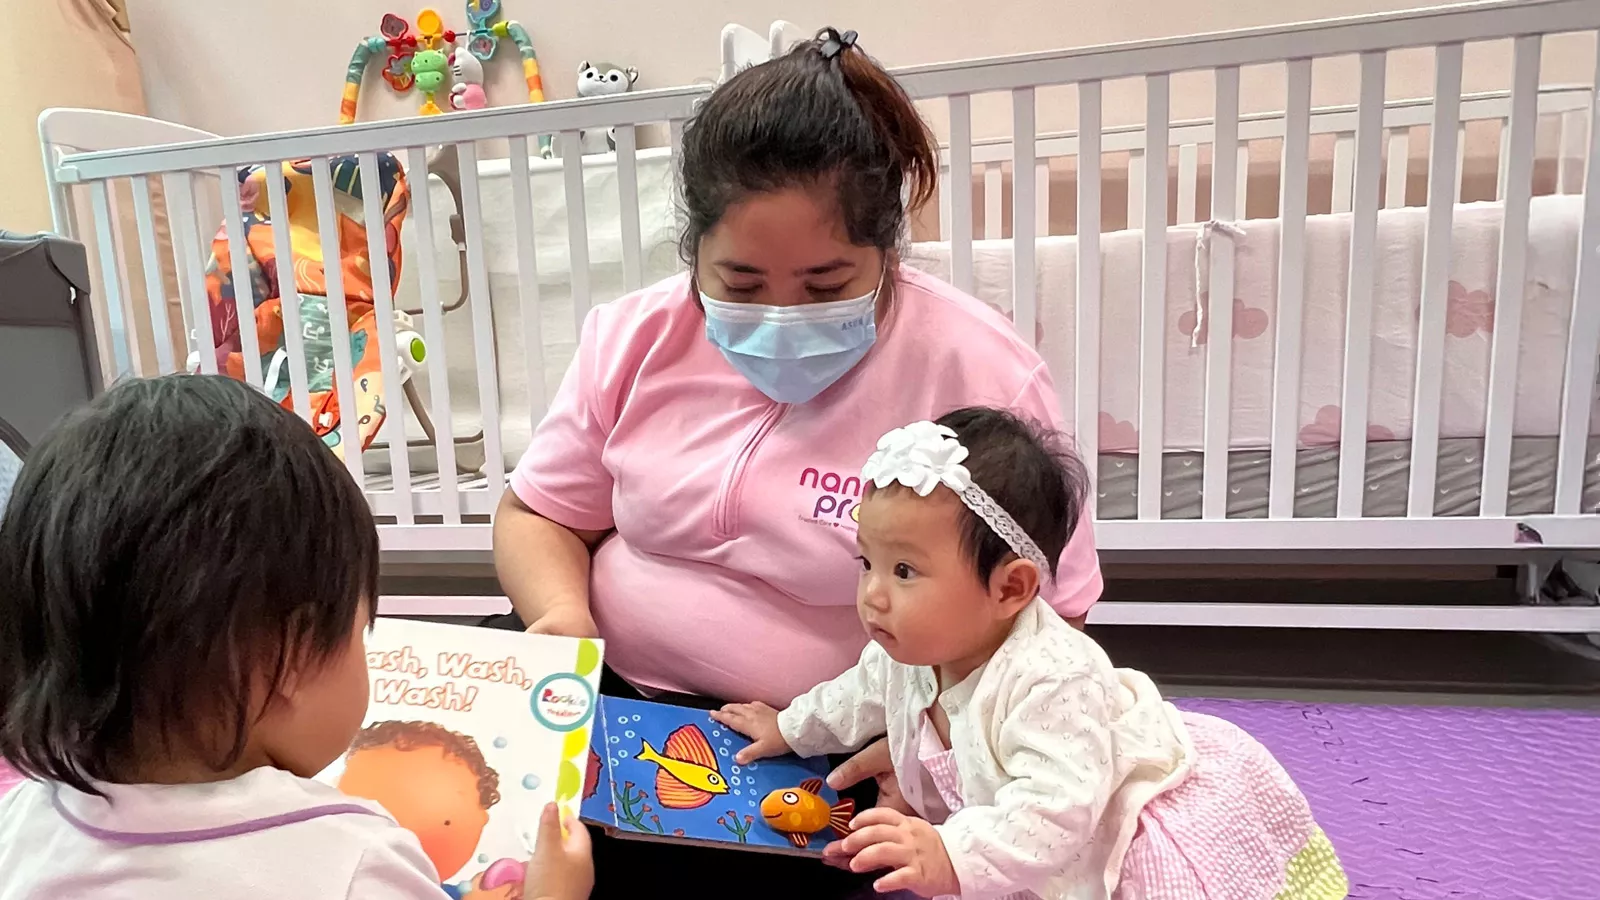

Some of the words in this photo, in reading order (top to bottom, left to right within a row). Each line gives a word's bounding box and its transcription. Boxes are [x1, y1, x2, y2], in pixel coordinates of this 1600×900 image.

[366, 646, 428, 679] ash,
[437, 652, 533, 691] Wash,
[375, 678, 478, 712] Wash!
